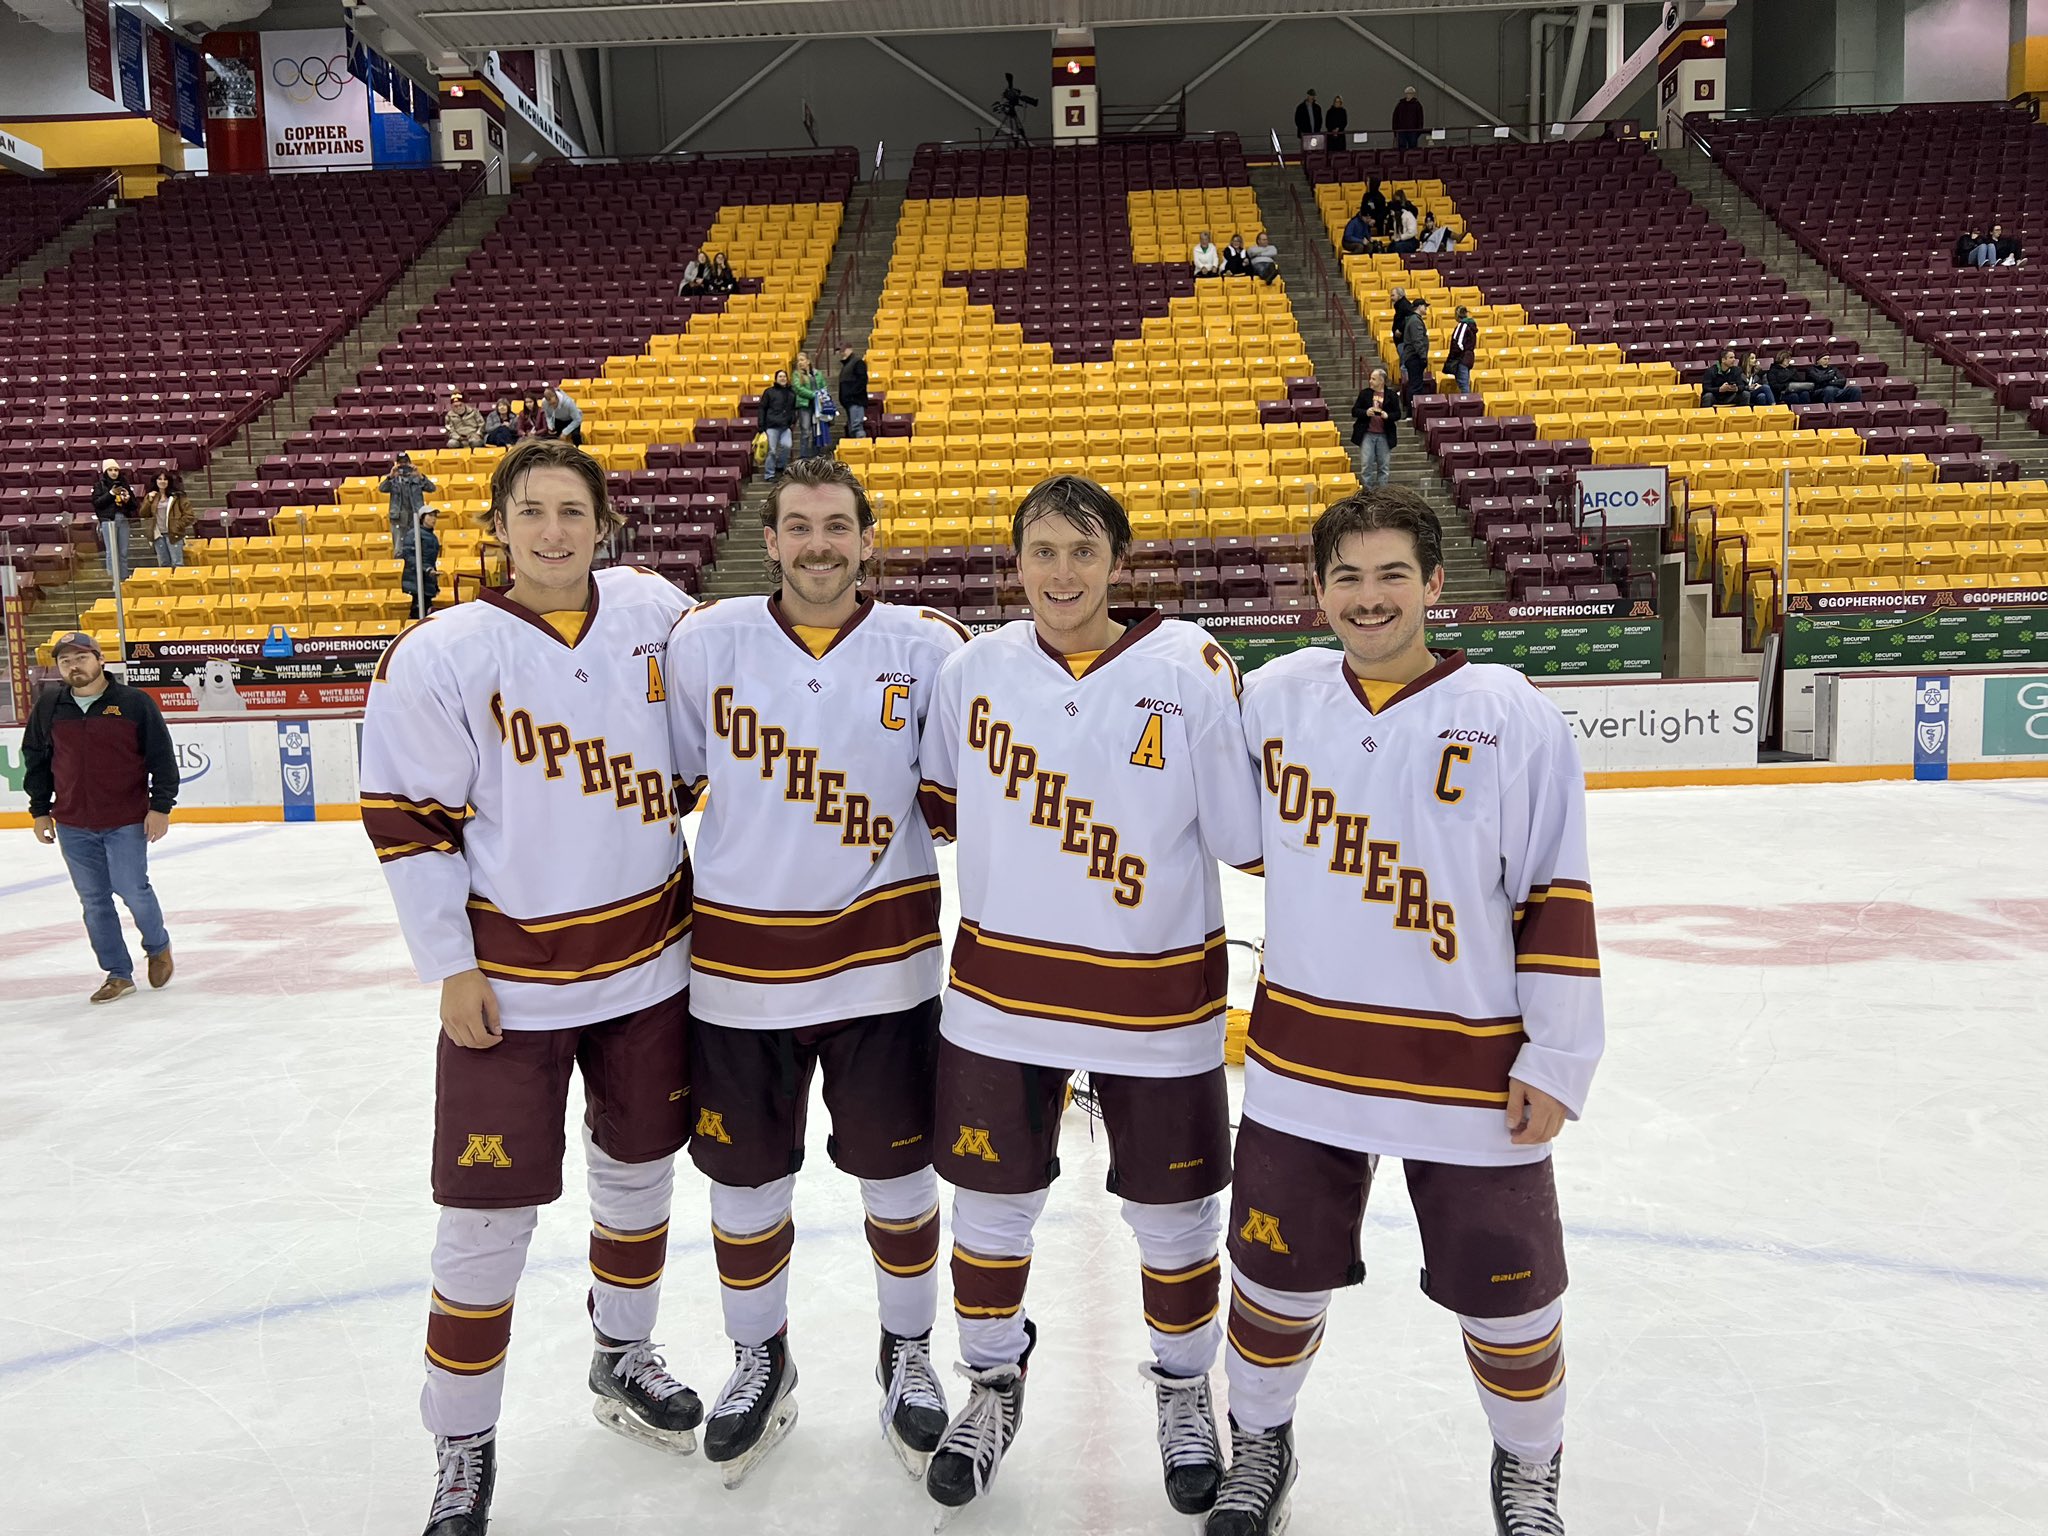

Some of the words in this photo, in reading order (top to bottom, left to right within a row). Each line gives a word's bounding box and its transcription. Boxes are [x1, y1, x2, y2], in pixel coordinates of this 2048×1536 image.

[1700, 83, 1710, 97] 9
[1070, 109, 1080, 123] 7
[284, 125, 348, 141] GOPHER
[458, 133, 468, 147] 5
[0, 134, 16, 153] AN
[275, 139, 364, 156] OLYMPIANS
[1583, 490, 1639, 508] ARCO
[1818, 595, 1927, 608] @GOPHERHOCKEY
[1963, 591, 2048, 604] @GOPHERHOC
[1509, 604, 1615, 617] @GOPHERHOCKEY
[1197, 614, 1301, 628] @GOPHERHOCKEY
[159, 644, 260, 656] @GOPHERHOCKEY
[5, 600, 26, 720] MINNESOTA
[355, 662, 376, 670] WHIT
[275, 664, 300, 672] WHITE
[277, 671, 322, 679] MITSUBISHI
[646, 655, 666, 703] A
[319, 688, 342, 696] WHITE
[321, 695, 364, 703] MITSUBISHI
[162, 698, 198, 706] MITSUBIS
[881, 684, 909, 731] C
[1141, 698, 1184, 716] WCCH
[1732, 705, 1754, 734] S
[1129, 713, 1166, 770] A
[711, 685, 895, 864] GOPHERS
[1433, 743, 1472, 805] C
[967, 695, 1147, 910] GOPHERS
[1263, 737, 1458, 965] GOPHERS
[891, 1134, 923, 1148] BAUER
[1168, 1157, 1204, 1170] BAUER
[1490, 1270, 1532, 1283] BAUER
